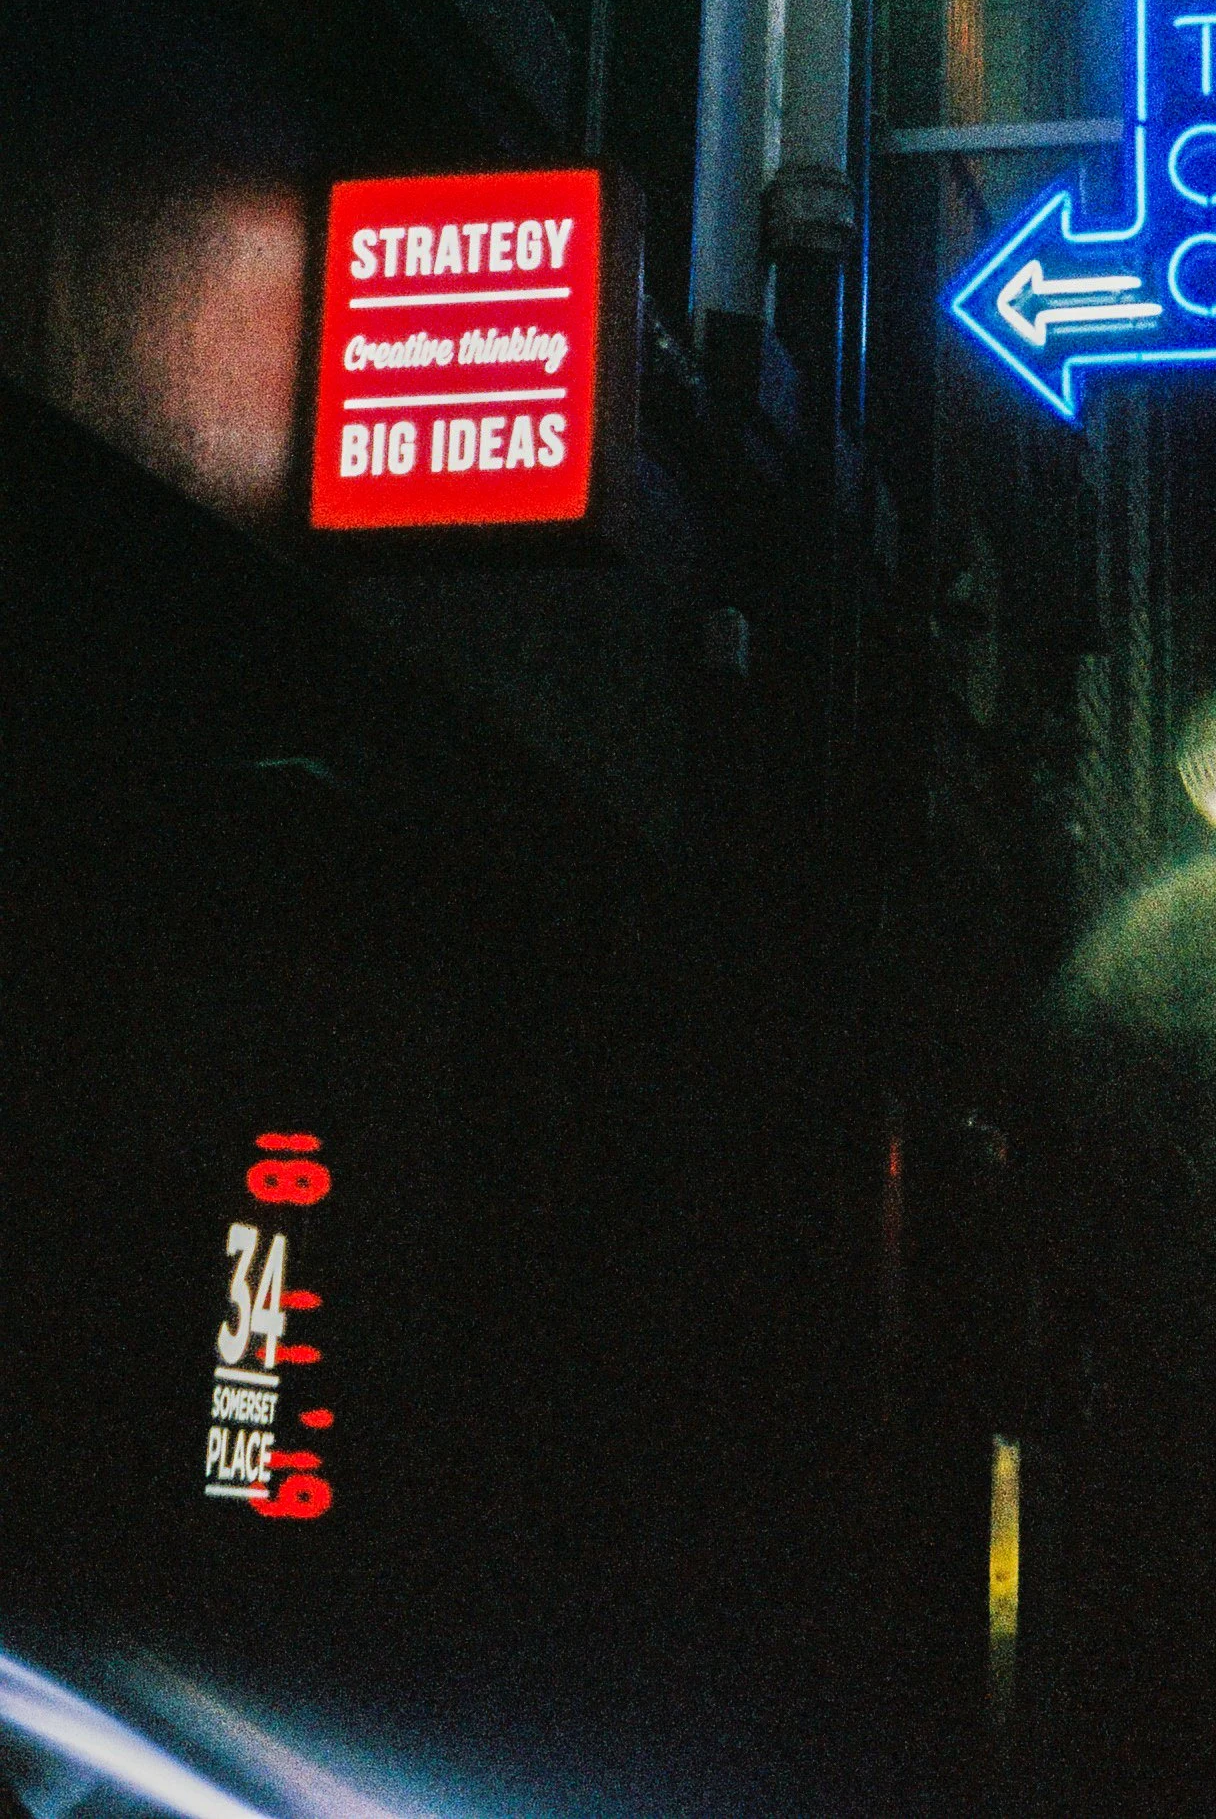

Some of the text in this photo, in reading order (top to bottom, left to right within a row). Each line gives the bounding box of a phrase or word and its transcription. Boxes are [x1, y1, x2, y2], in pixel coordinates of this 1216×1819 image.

[350, 218, 574, 280] STRATEGY
[343, 325, 569, 374] Creative thinking
[340, 413, 567, 478] BIG IDEAS
[216, 1222, 287, 1370] 34
[211, 1384, 279, 1425] SOMERSET
[205, 1425, 275, 1483] PLACE
